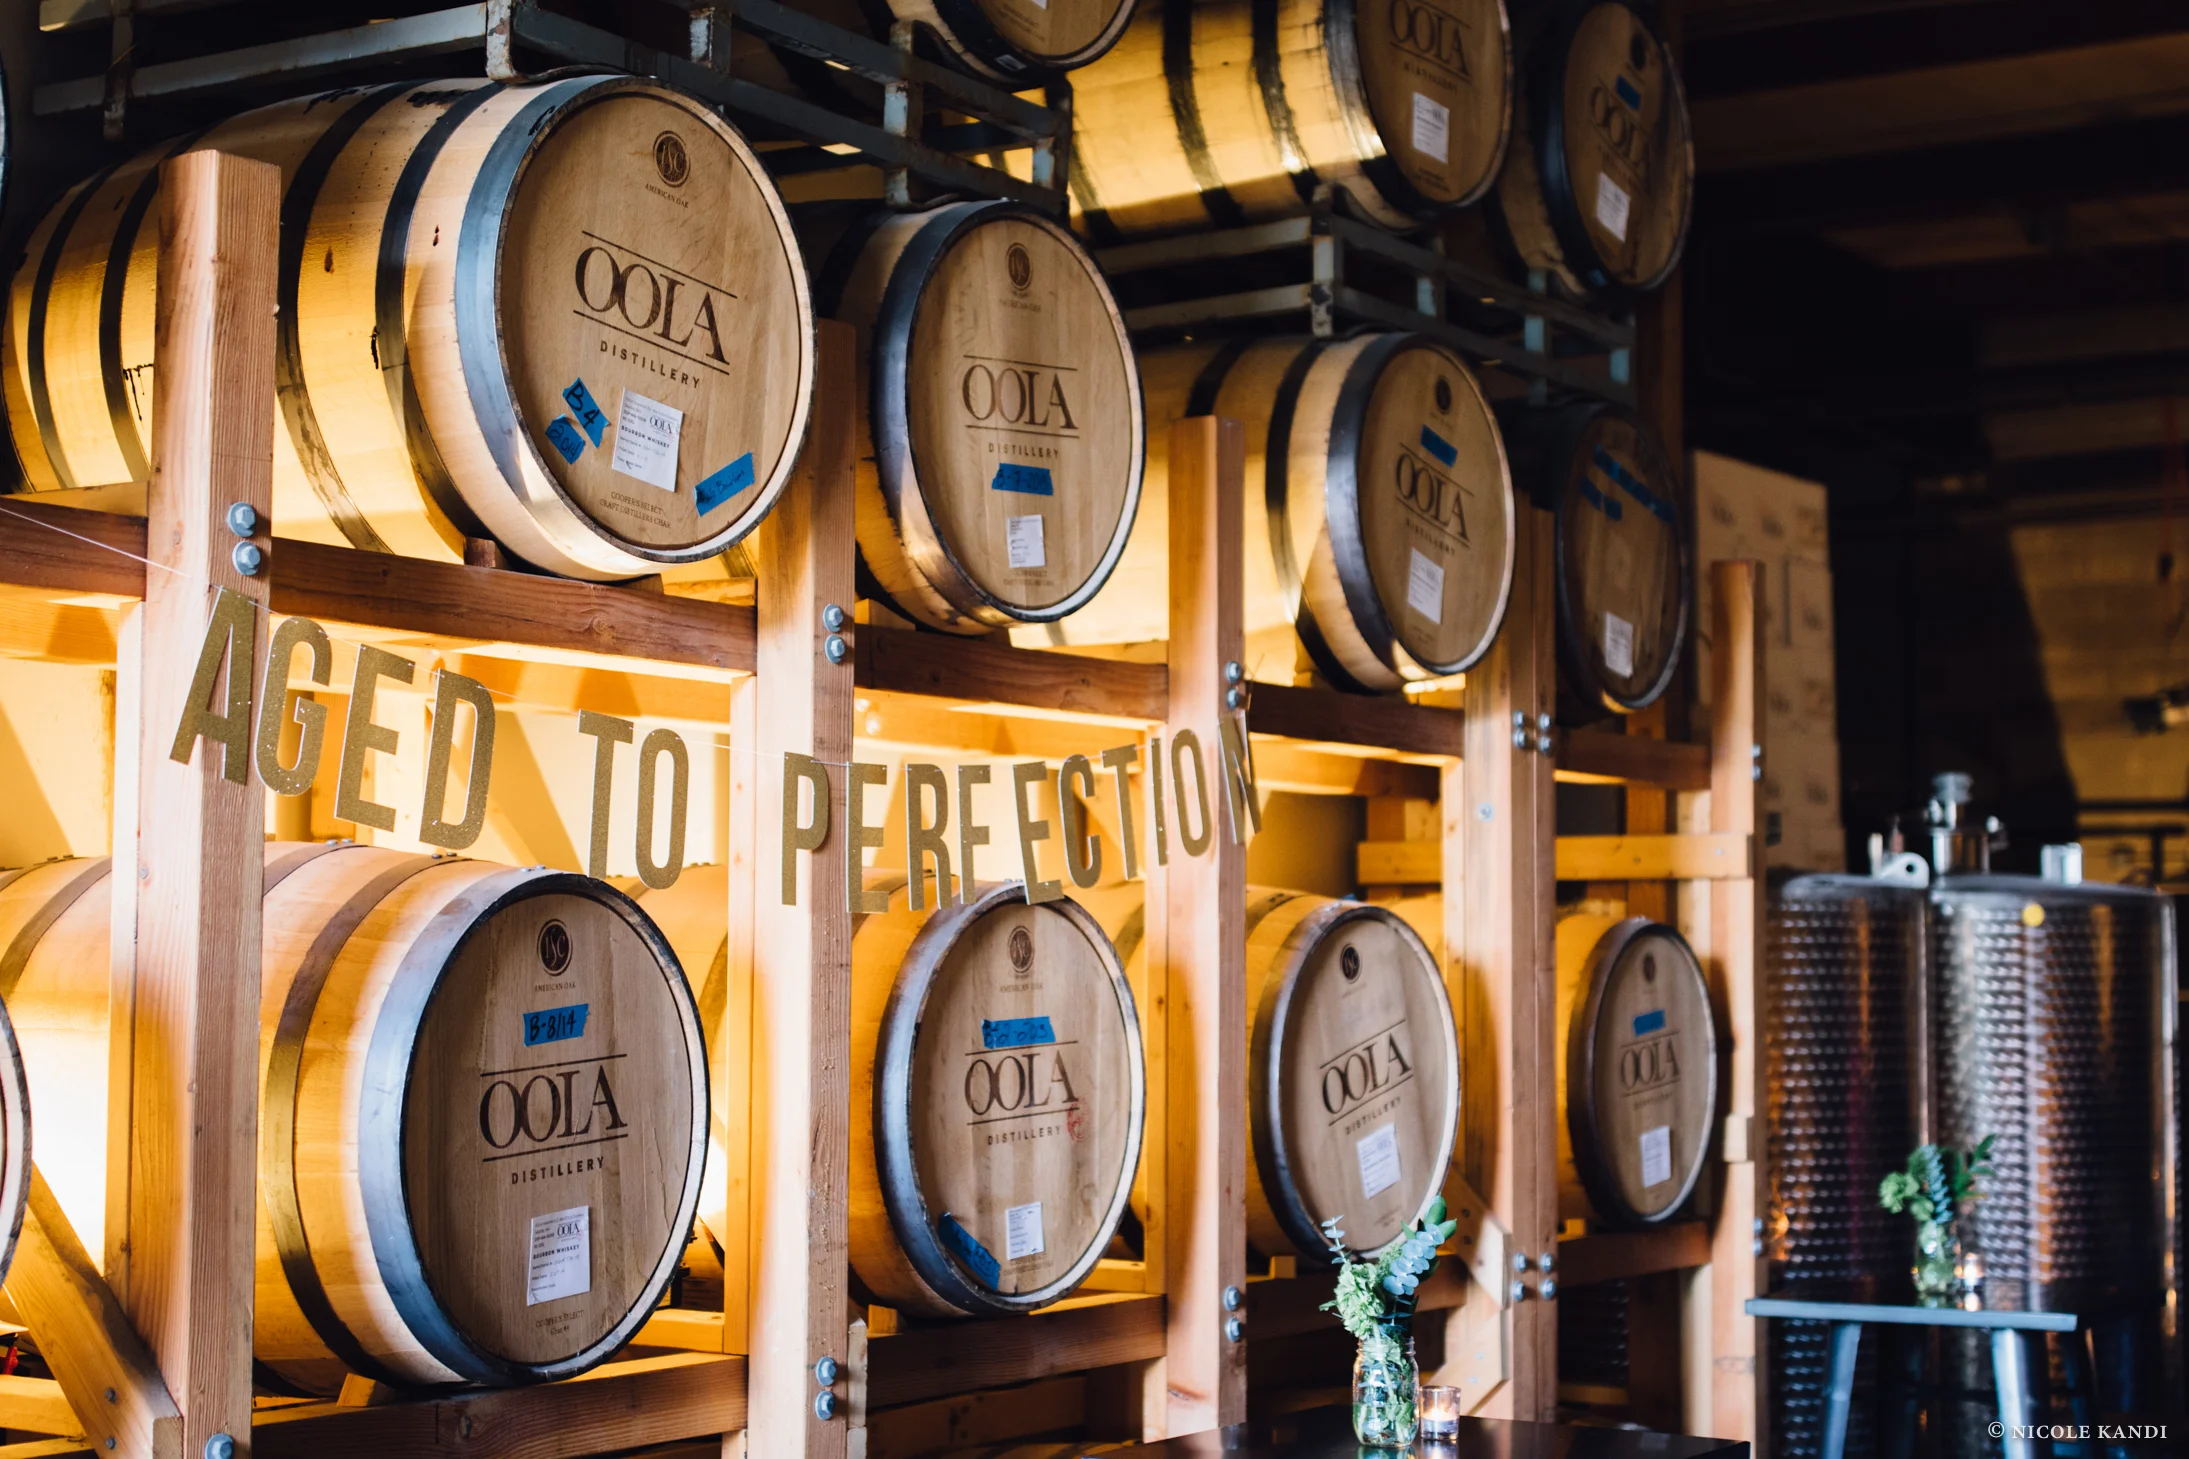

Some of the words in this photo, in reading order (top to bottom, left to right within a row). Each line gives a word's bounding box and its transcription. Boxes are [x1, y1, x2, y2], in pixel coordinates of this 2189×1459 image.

[1388, 0, 1471, 76] OOLA
[645, 183, 676, 202] AMERICAN
[675, 197, 689, 208] OAK
[575, 246, 730, 365] OOLA
[600, 340, 700, 388] DISTILLERY
[962, 364, 1079, 430] OOLA
[621, 425, 646, 438] BOURBON
[647, 435, 670, 448] WHISKEY
[649, 415, 672, 434] OOLA
[988, 443, 1059, 459] DISTILLERY
[600, 498, 619, 511] CRAFT
[620, 505, 653, 523] DISTILLERS
[653, 516, 671, 529] CHAR
[1396, 453, 1470, 541] OOLA
[169, 585, 496, 850] AGED
[578, 708, 689, 890] TO
[781, 709, 1262, 913] PERFECTION
[534, 982, 563, 992] AMERICAN
[564, 981, 577, 990] OAK
[529, 1009, 577, 1041] B-8/14
[1322, 1032, 1412, 1115] OOLA
[1620, 1037, 1681, 1091] OOLA
[965, 1050, 1079, 1116] OOLA
[480, 1065, 628, 1149] OOLA
[1345, 1096, 1401, 1135] DISTILLERY
[987, 1126, 1061, 1146] DISTILLERY
[511, 1156, 604, 1185] DISTILLERY
[557, 1222, 580, 1237] OOLA
[533, 1250, 555, 1260] BOURBON
[556, 1244, 580, 1254] WHISKEY
